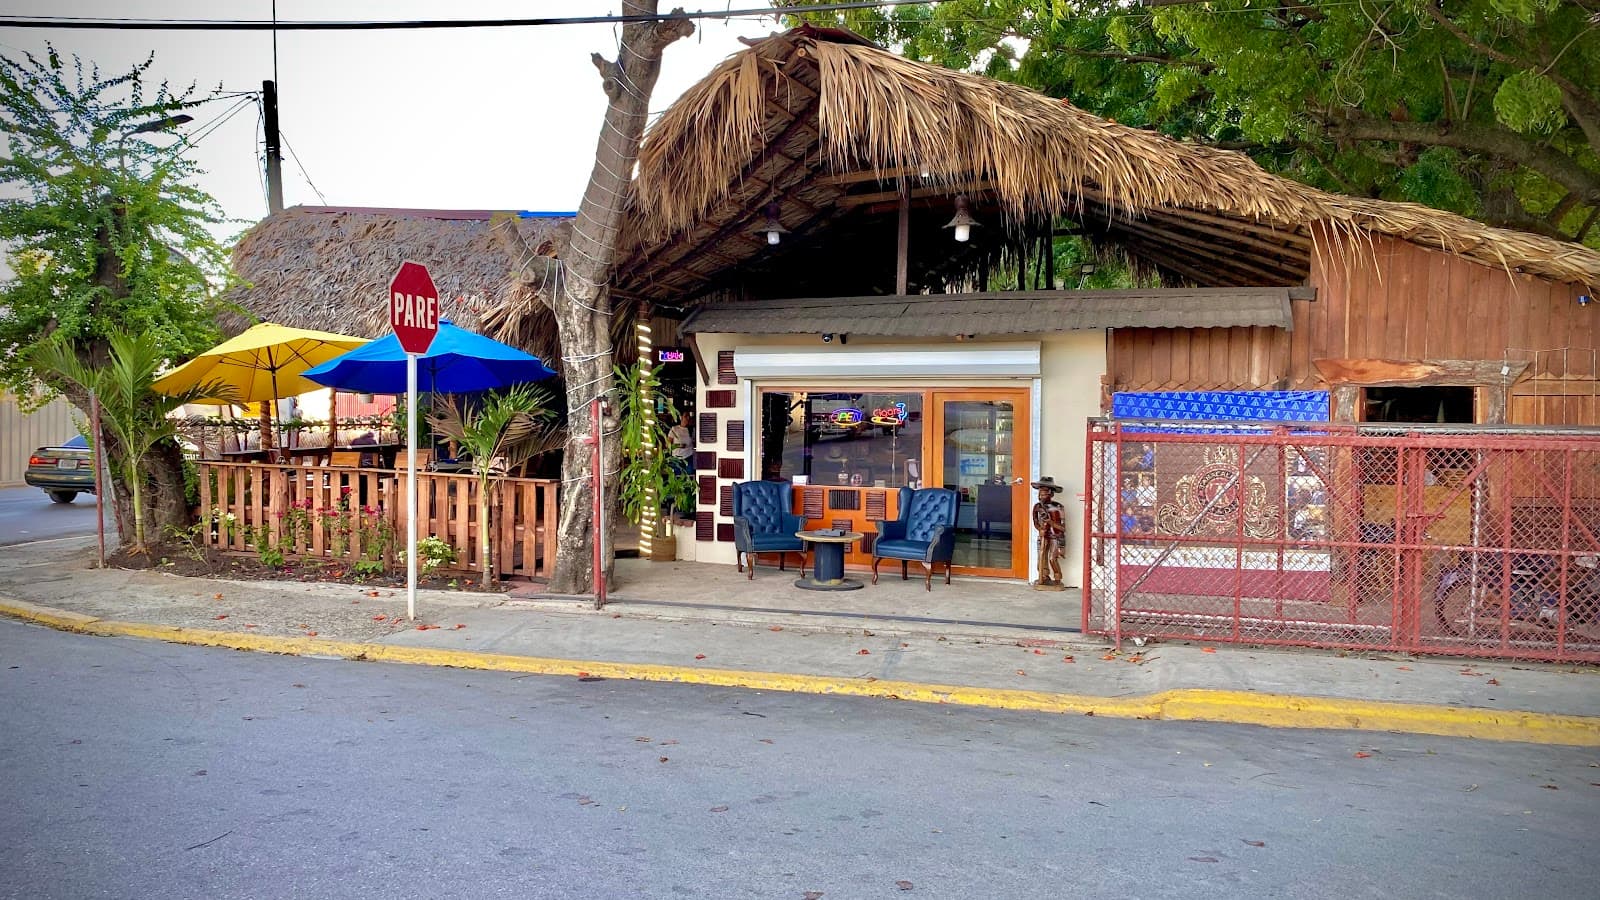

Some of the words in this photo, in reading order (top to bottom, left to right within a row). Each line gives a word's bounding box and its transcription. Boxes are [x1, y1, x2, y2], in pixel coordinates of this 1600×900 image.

[394, 292, 436, 330] PARE
[831, 411, 862, 422] OPEN
[873, 407, 902, 418] Cigars
